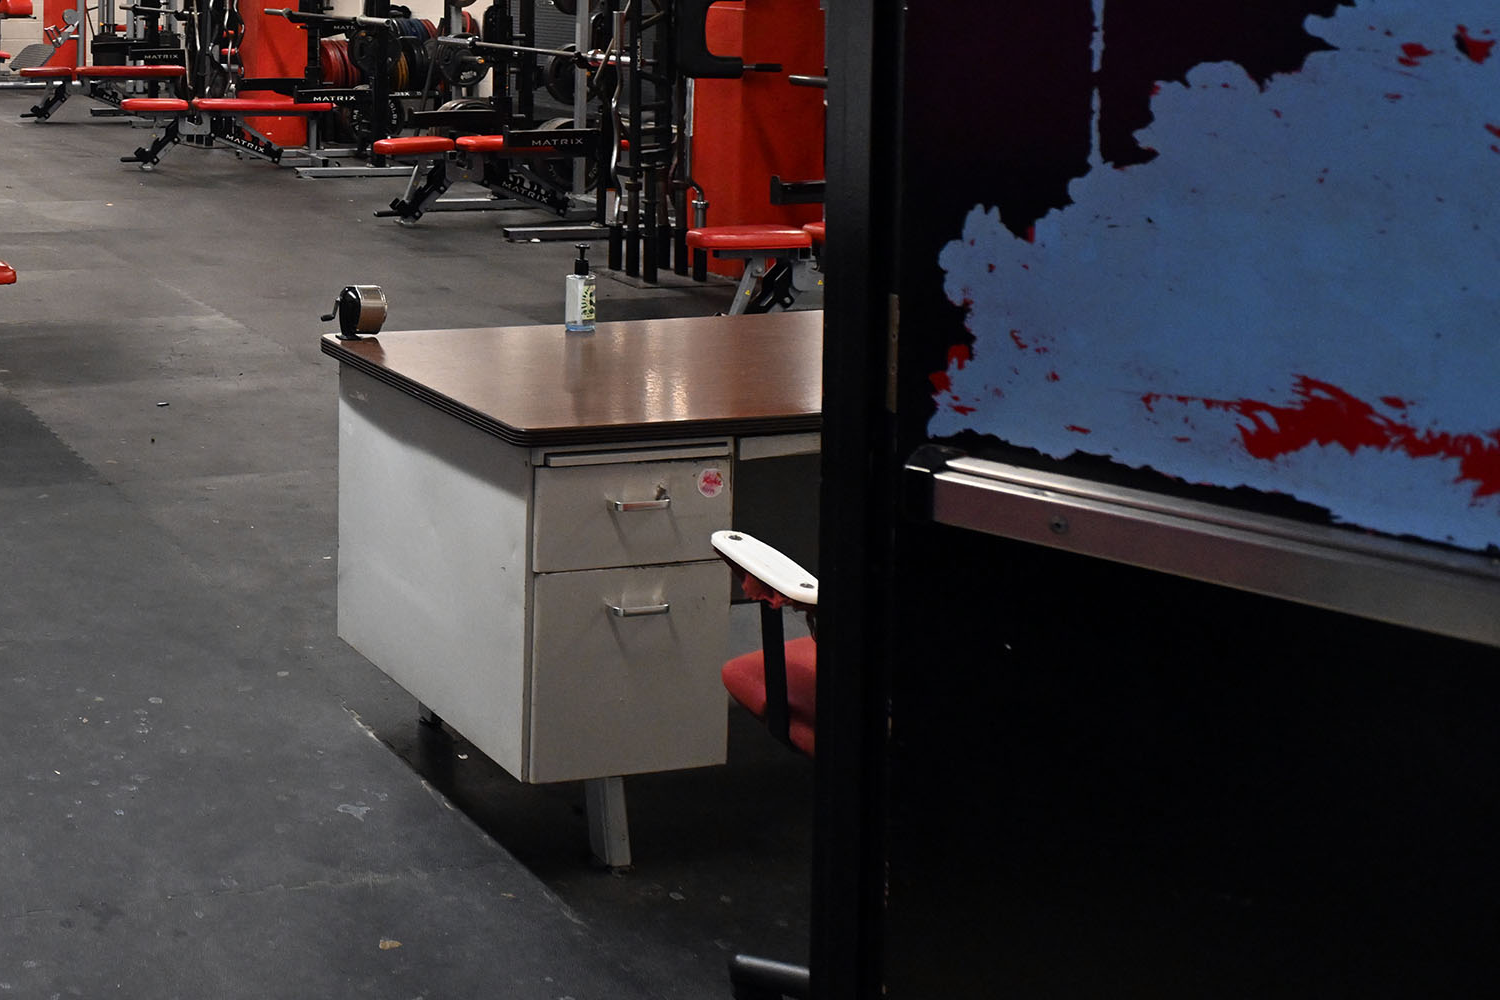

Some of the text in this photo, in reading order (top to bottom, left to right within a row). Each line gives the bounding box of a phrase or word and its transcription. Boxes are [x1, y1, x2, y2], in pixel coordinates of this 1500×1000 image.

[225, 133, 265, 153] MATRIX
[531, 138, 584, 146] MATRIX
[502, 181, 548, 204] MATRIX
